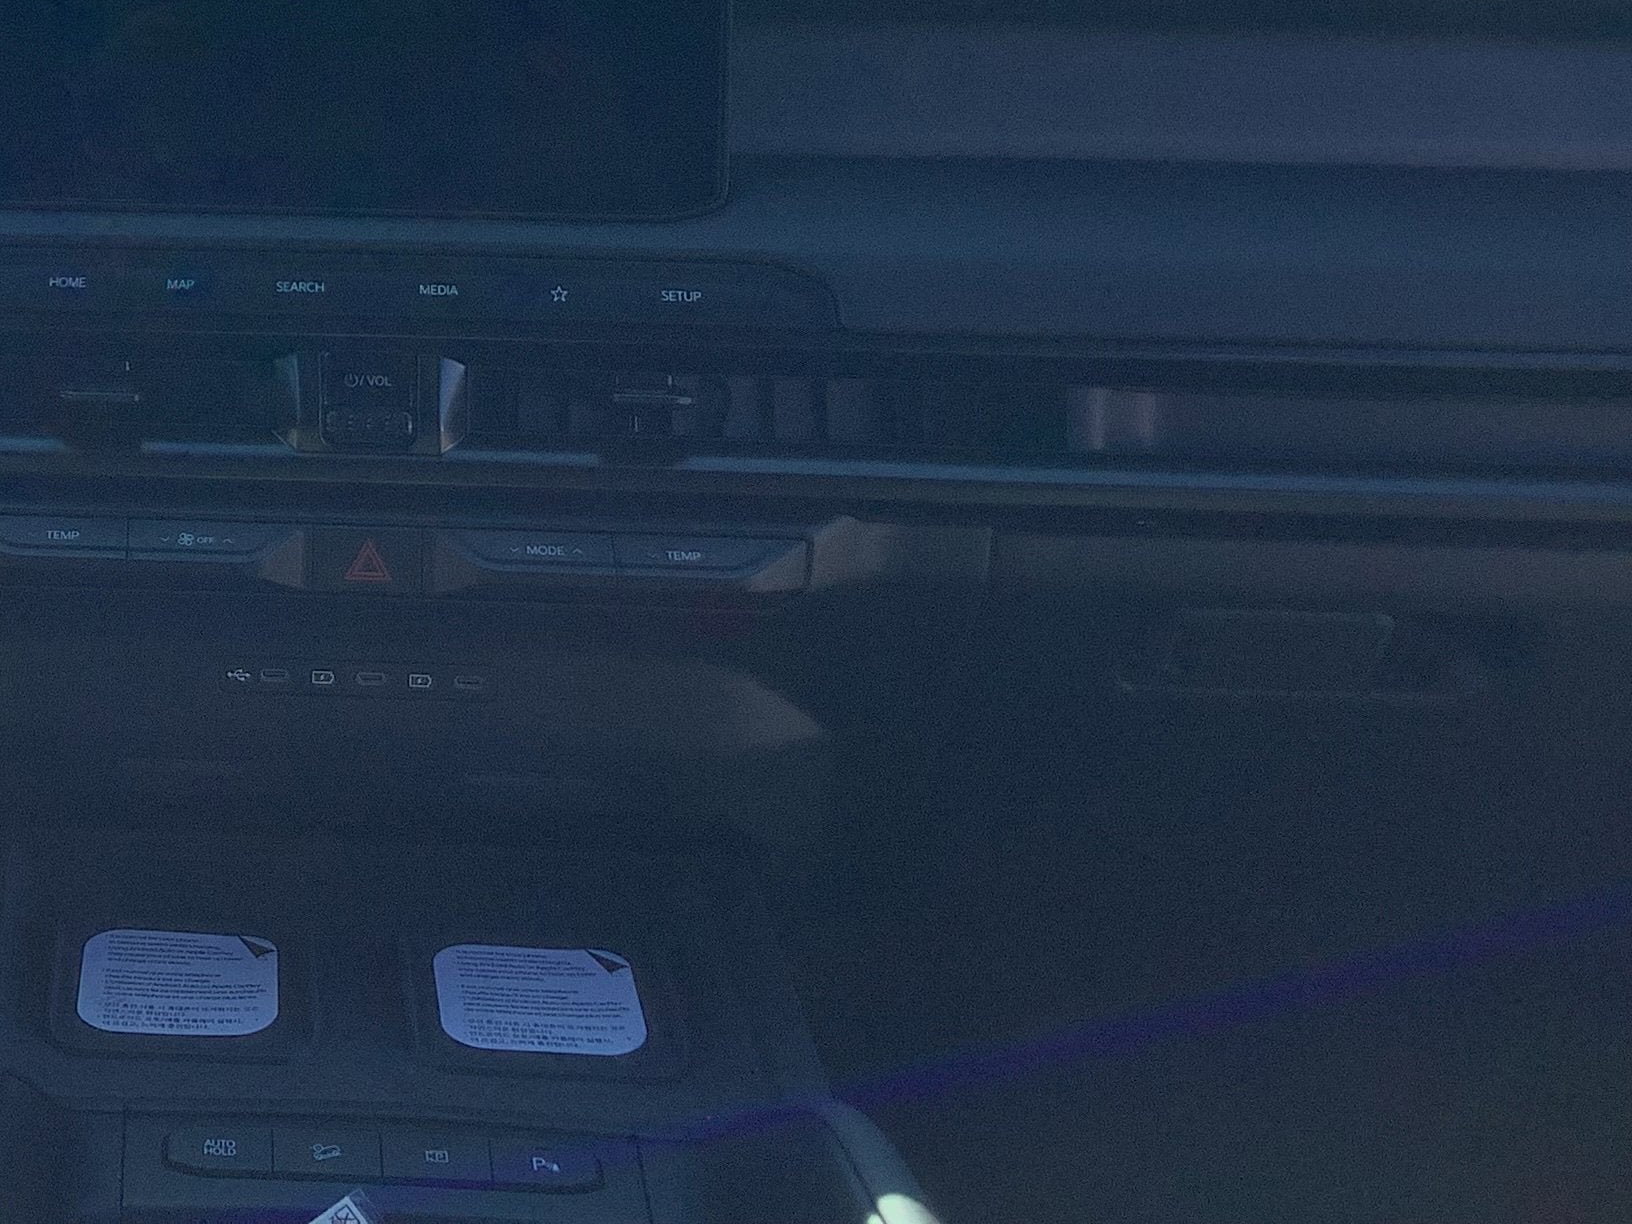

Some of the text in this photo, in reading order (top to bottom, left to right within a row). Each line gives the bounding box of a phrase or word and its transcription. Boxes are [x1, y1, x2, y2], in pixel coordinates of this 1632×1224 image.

[48, 277, 87, 288] HOME
[167, 278, 195, 290] MAP
[275, 281, 325, 293] SEARCH
[419, 284, 459, 296] MEDIA
[661, 289, 702, 302] SETUP
[46, 530, 80, 540] TEMP
[526, 545, 565, 556] MODE
[665, 550, 702, 561] TEMP
[204, 1138, 236, 1148] AUTO
[203, 1147, 237, 1156] HOLD
